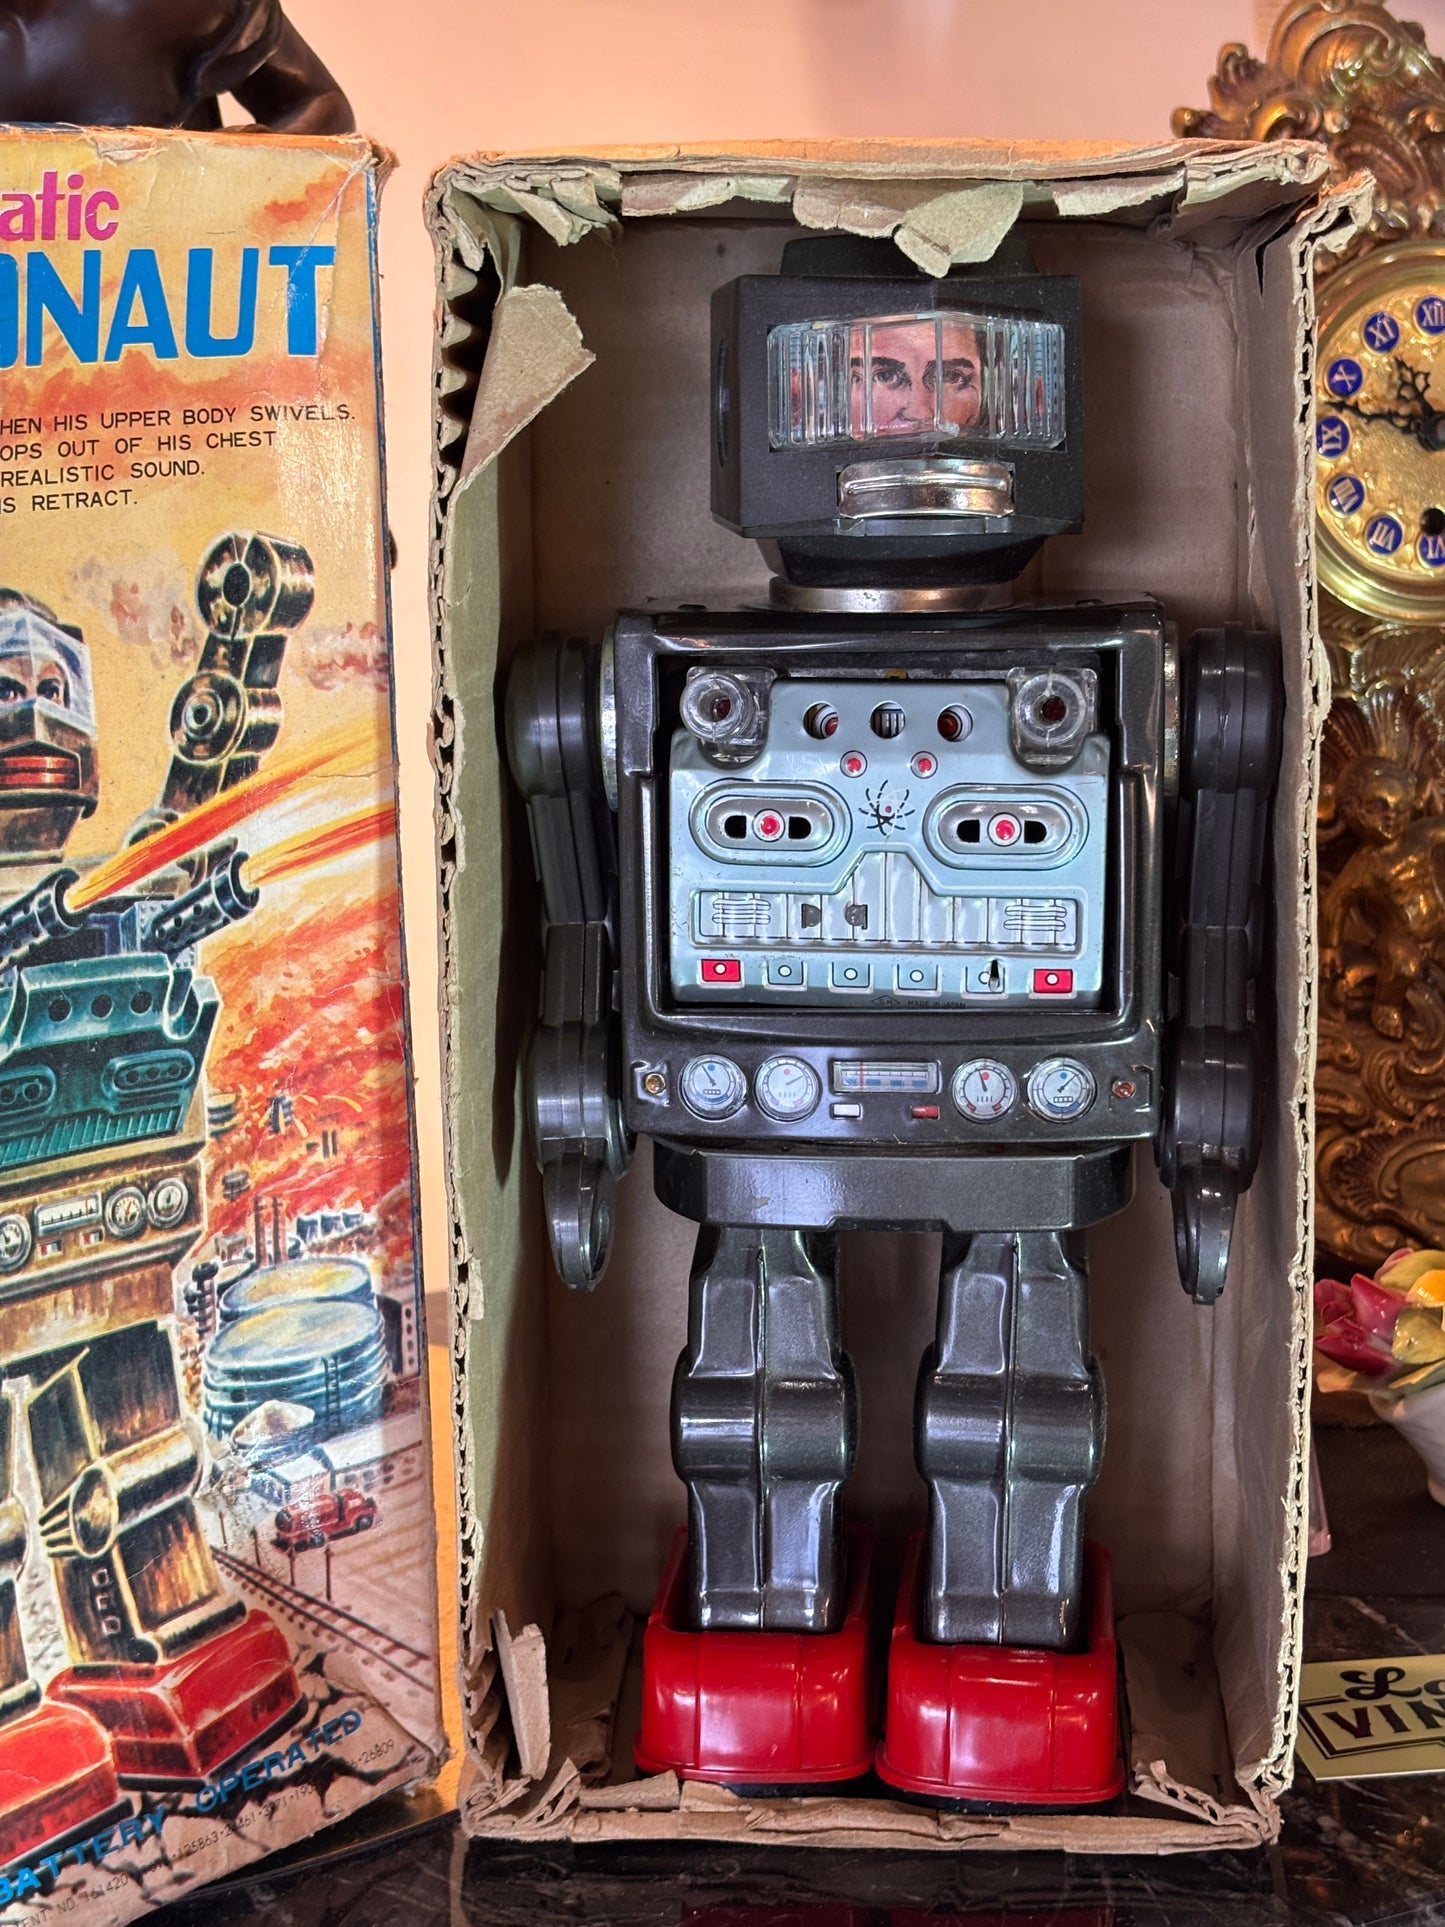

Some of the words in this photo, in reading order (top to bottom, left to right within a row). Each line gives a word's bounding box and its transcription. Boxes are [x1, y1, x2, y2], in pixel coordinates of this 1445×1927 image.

[0, 170, 119, 241] atic
[1367, 314, 1396, 349] XI
[1332, 363, 1358, 392] X
[0, 416, 42, 435] HEN
[53, 413, 88, 432] HIS
[100, 409, 171, 429] UPPER
[182, 402, 237, 425] BODY
[250, 403, 356, 422] SWIVELS.
[0, 442, 42, 461] OPS
[57, 439, 100, 458] OUT
[115, 436, 143, 454] OF
[157, 433, 192, 452] HIS
[206, 430, 277, 449] CHEST
[1321, 423, 1342, 450] IX
[0, 463, 115, 488] REALISTIC
[130, 459, 205, 479] SOUND.
[0, 496, 16, 515] S
[31, 488, 138, 512] RETRACT.
[195, 1709, 362, 1813] OPERATED
[58, 1894, 79, 1914] NO.
